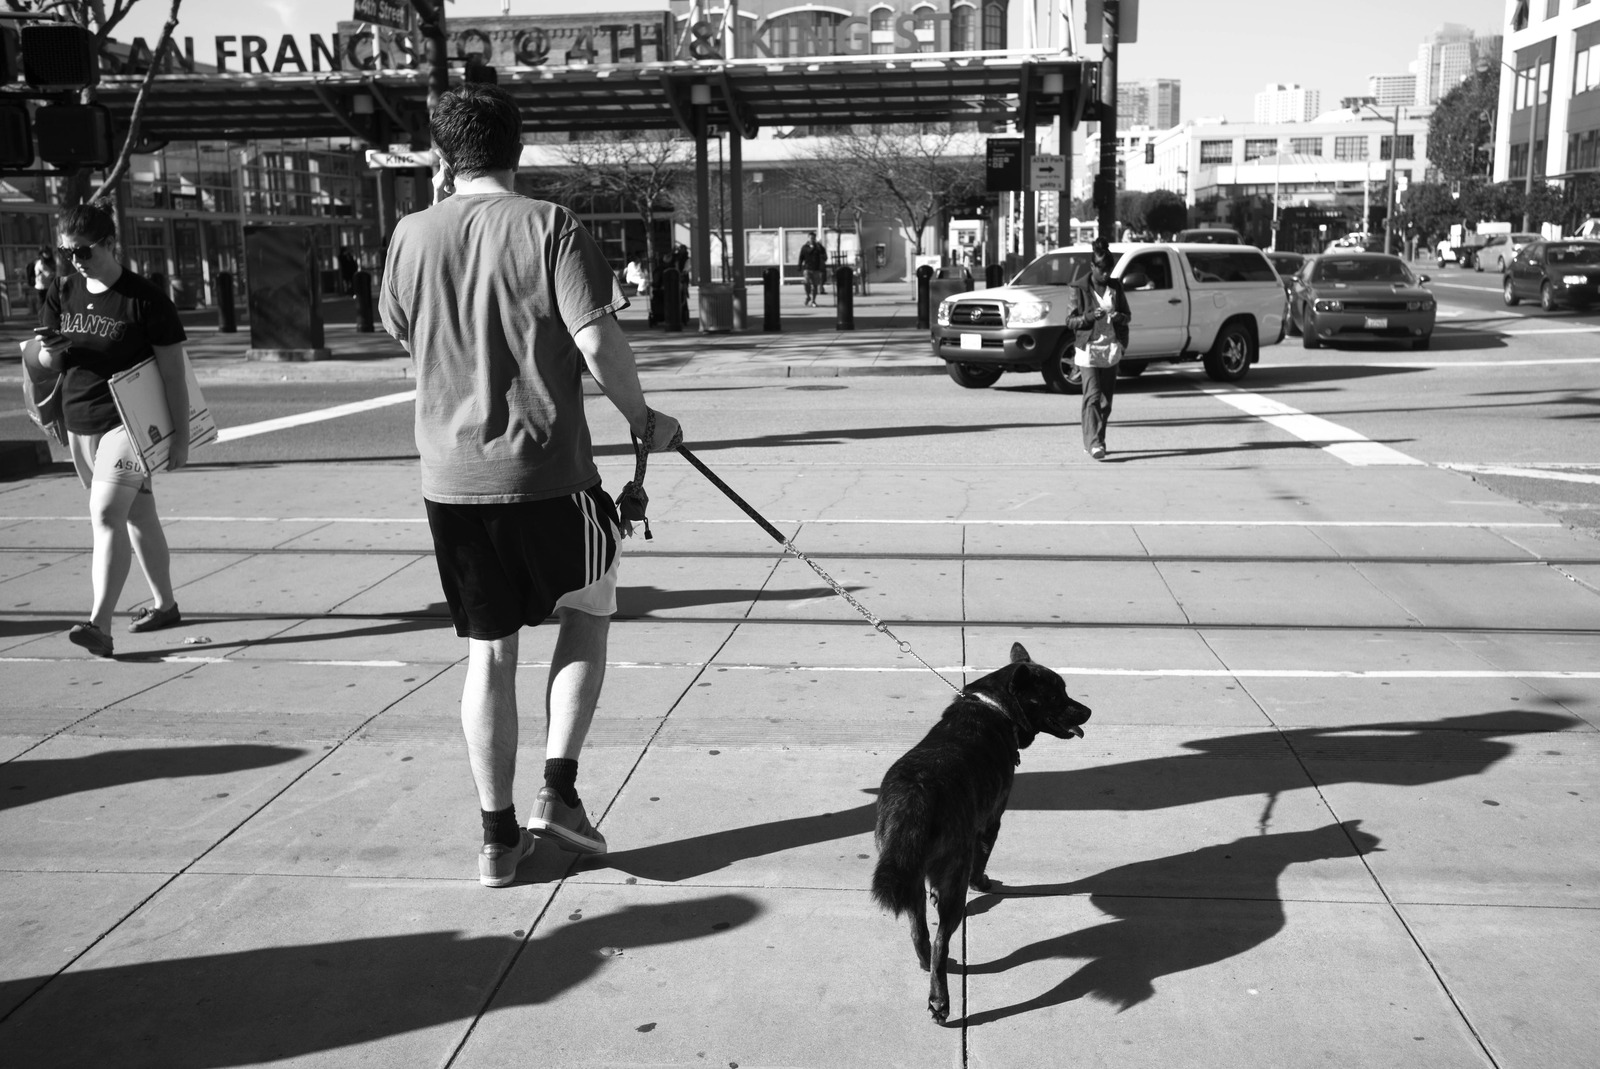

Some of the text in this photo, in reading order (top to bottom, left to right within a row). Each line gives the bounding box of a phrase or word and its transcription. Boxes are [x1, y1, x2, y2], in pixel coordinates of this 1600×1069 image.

[360, 0, 404, 23] 4th Street
[215, 28, 492, 73] FRANCISO
[513, 26, 550, 66] @
[565, 23, 663, 65] 4TH
[689, 20, 724, 60] &
[748, 16, 869, 58] KING
[895, 12, 951, 53] ST
[386, 155, 414, 164] KING
